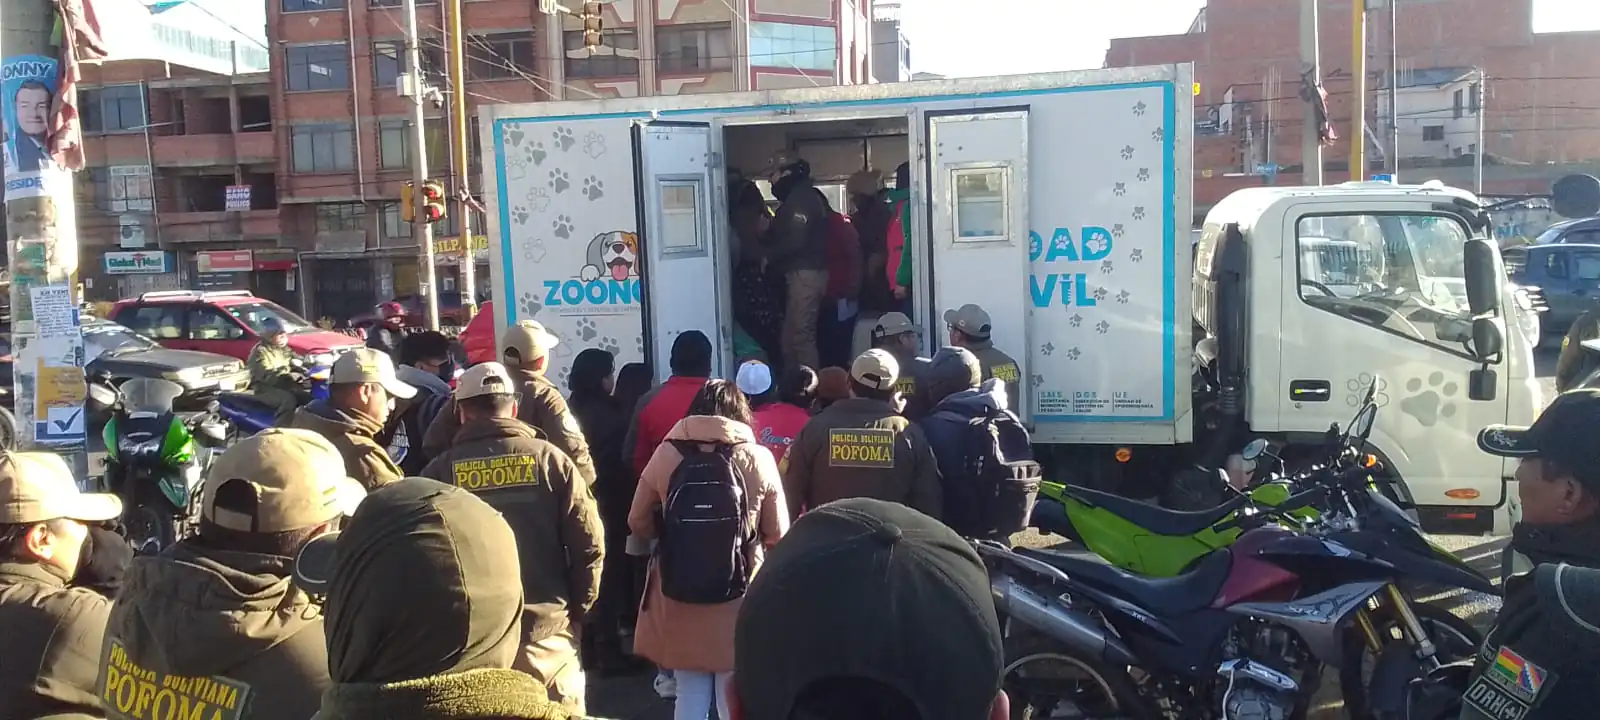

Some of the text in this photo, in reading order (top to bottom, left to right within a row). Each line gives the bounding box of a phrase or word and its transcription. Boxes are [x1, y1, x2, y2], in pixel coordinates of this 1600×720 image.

[832, 433, 892, 444] POLICIA BOLIVIANA
[831, 445, 892, 462] POFOMA
[455, 455, 536, 472] POLICIA BOLIVIANA
[456, 464, 537, 489] POFOMA
[109, 643, 238, 710] POLICIA BOLIVIANA
